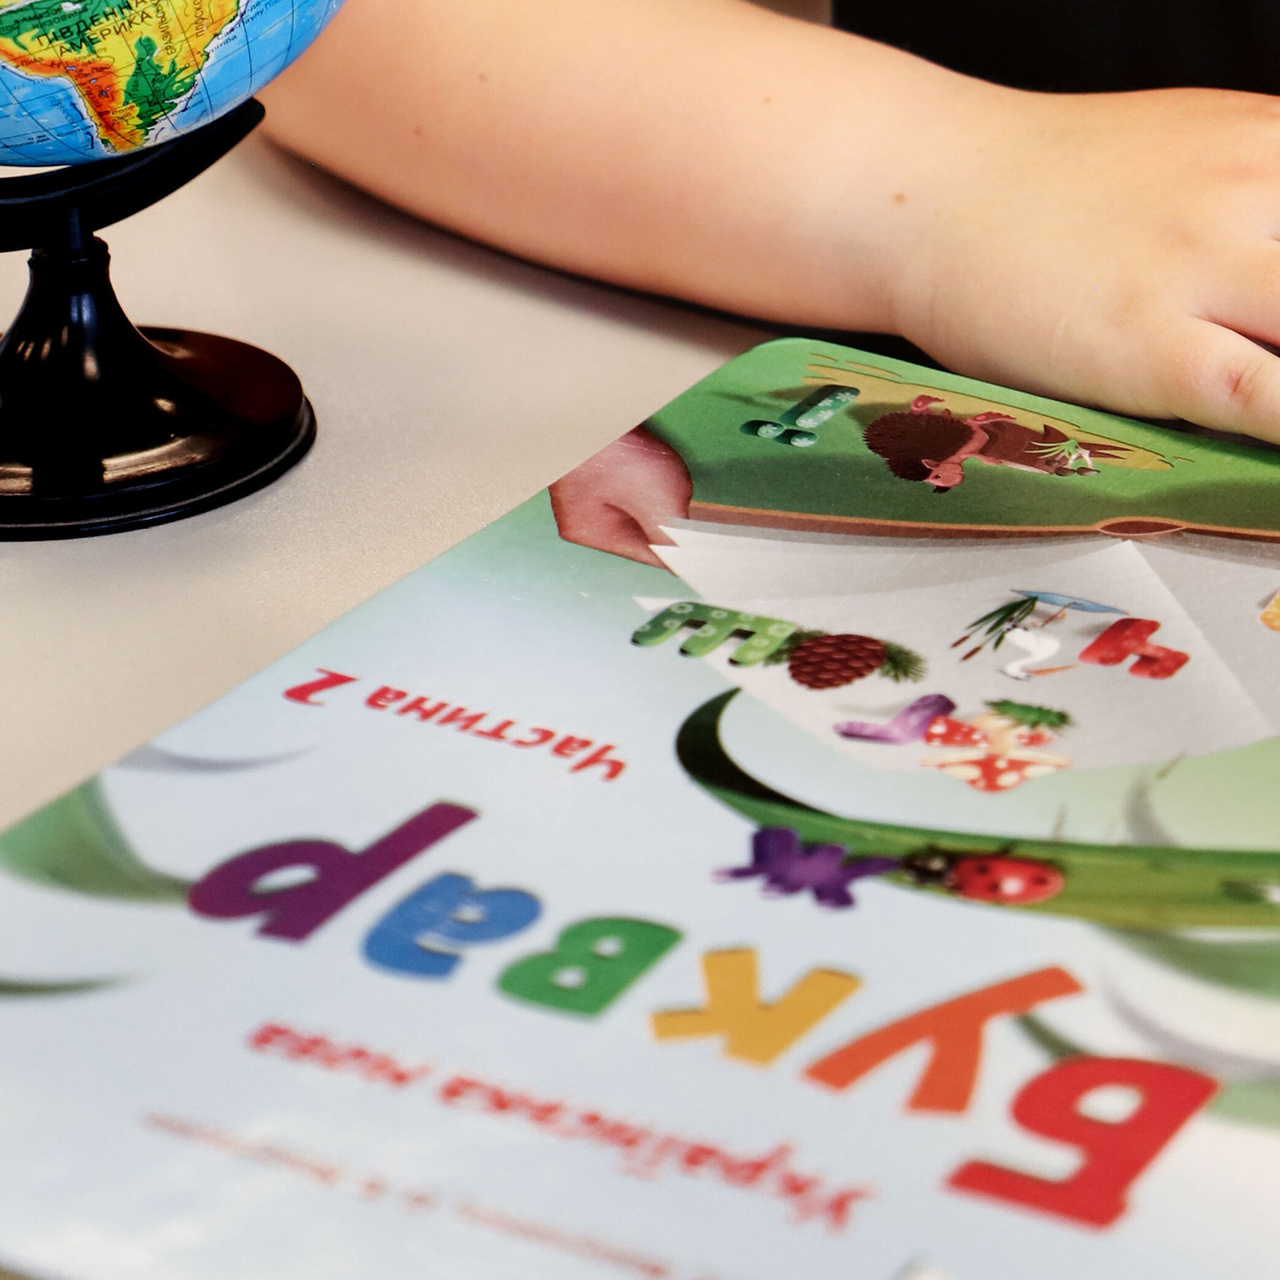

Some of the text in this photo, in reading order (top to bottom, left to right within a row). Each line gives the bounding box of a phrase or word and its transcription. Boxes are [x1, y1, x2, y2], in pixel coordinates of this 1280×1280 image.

[59, 9, 152, 57] АМЕРИКА
[283, 667, 627, 782] Частина 2
[186, 799, 1222, 1233] Буквар
